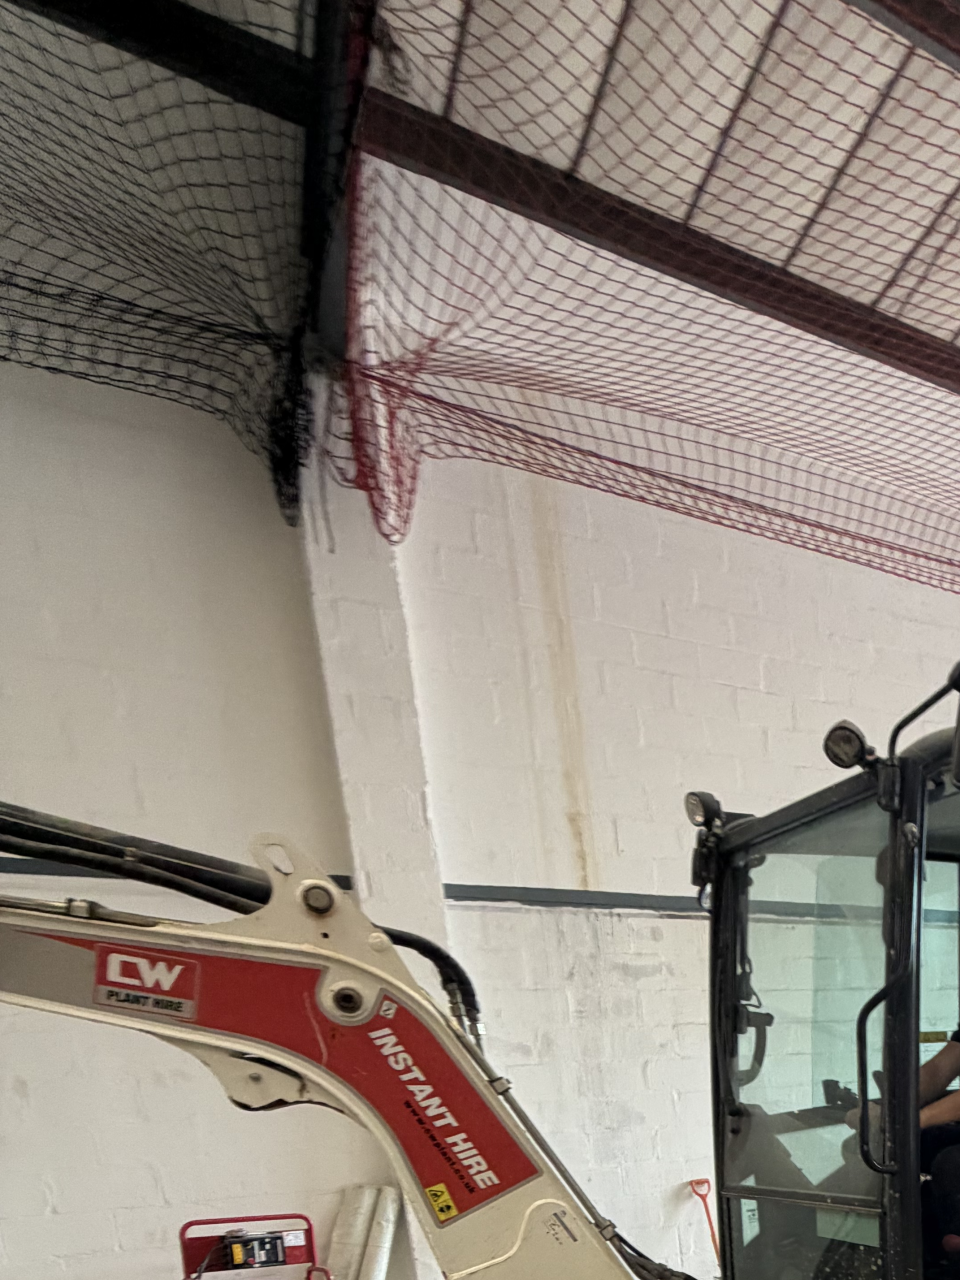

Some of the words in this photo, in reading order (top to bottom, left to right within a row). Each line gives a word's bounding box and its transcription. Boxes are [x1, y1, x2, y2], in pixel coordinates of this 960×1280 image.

[106, 952, 185, 991] CW
[106, 989, 149, 1007] PLANT
[151, 997, 184, 1013] HIRE
[367, 1027, 459, 1128] INSTANT
[444, 1132, 501, 1190] HIRE
